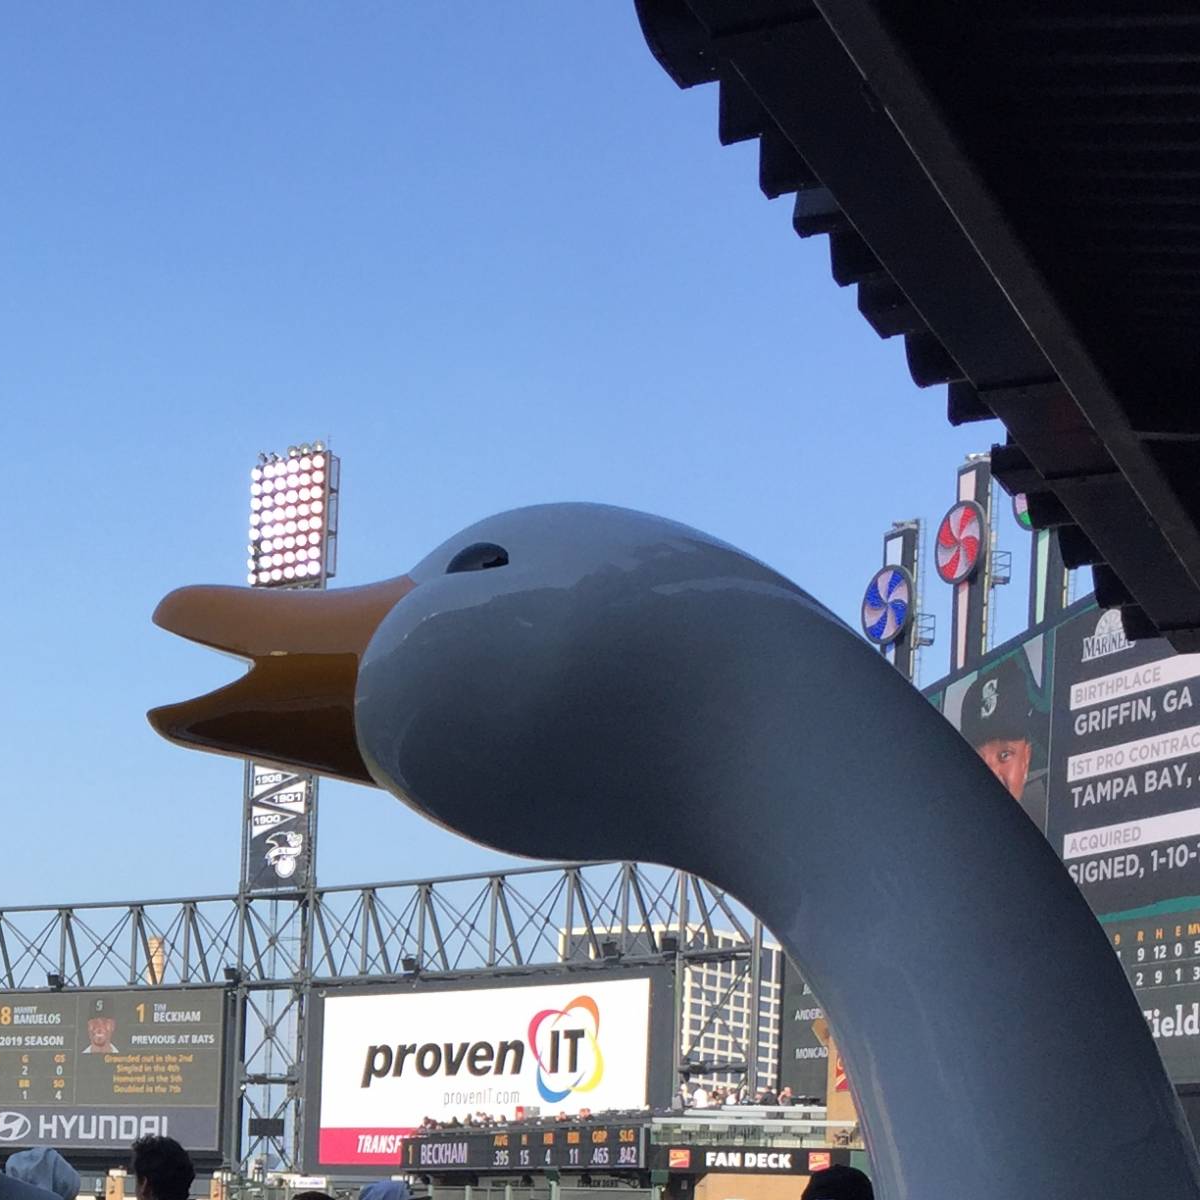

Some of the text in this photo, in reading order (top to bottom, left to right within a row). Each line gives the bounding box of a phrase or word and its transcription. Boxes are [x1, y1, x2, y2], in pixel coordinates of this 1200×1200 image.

[1075, 667, 1161, 703] BIRTHPLACE
[1074, 686, 1193, 736] GRIFFIN, GA
[1072, 758, 1092, 776] 1ST
[1097, 752, 1124, 770] PRO
[1071, 763, 1192, 808] TAMPA BAY,
[1069, 826, 1142, 853] ACQUIRED
[1069, 842, 1200, 884] SIGNED, 1-10-
[1137, 931, 1144, 942] R
[1155, 928, 1163, 939] H
[1175, 926, 1181, 937] E
[1137, 948, 1145, 961] 9
[1154, 945, 1167, 959] 12
[1174, 943, 1182, 956] 0
[1136, 973, 1143, 986] 2
[1155, 971, 1162, 984] 9
[1175, 968, 1181, 981] 1
[13, 1014, 61, 1024] BANUELOS
[136, 1003, 145, 1023] 1
[153, 1011, 201, 1022] BECKHAM
[0, 1035, 64, 1046] 2019 SEASON
[131, 1034, 215, 1044] PREVIOUS AT BATS
[361, 1029, 585, 1088] proven IT
[22, 1065, 28, 1075] 2
[56, 1065, 63, 1075] 0
[22, 1090, 62, 1100] 1 4
[443, 1088, 520, 1107] provenIT.com
[39, 1114, 168, 1140] HYUNDAI
[357, 1135, 406, 1153] TRANSF
[493, 1134, 509, 1147] AVG
[619, 1127, 634, 1142] SLG
[407, 1143, 468, 1165] 1 BECKHAM
[519, 1150, 530, 1165] 15
[544, 1149, 551, 1165] 4
[569, 1149, 579, 1164] 11
[590, 1148, 609, 1164] .465
[617, 1147, 637, 1164] .842
[706, 1152, 792, 1168] FAN DECK
